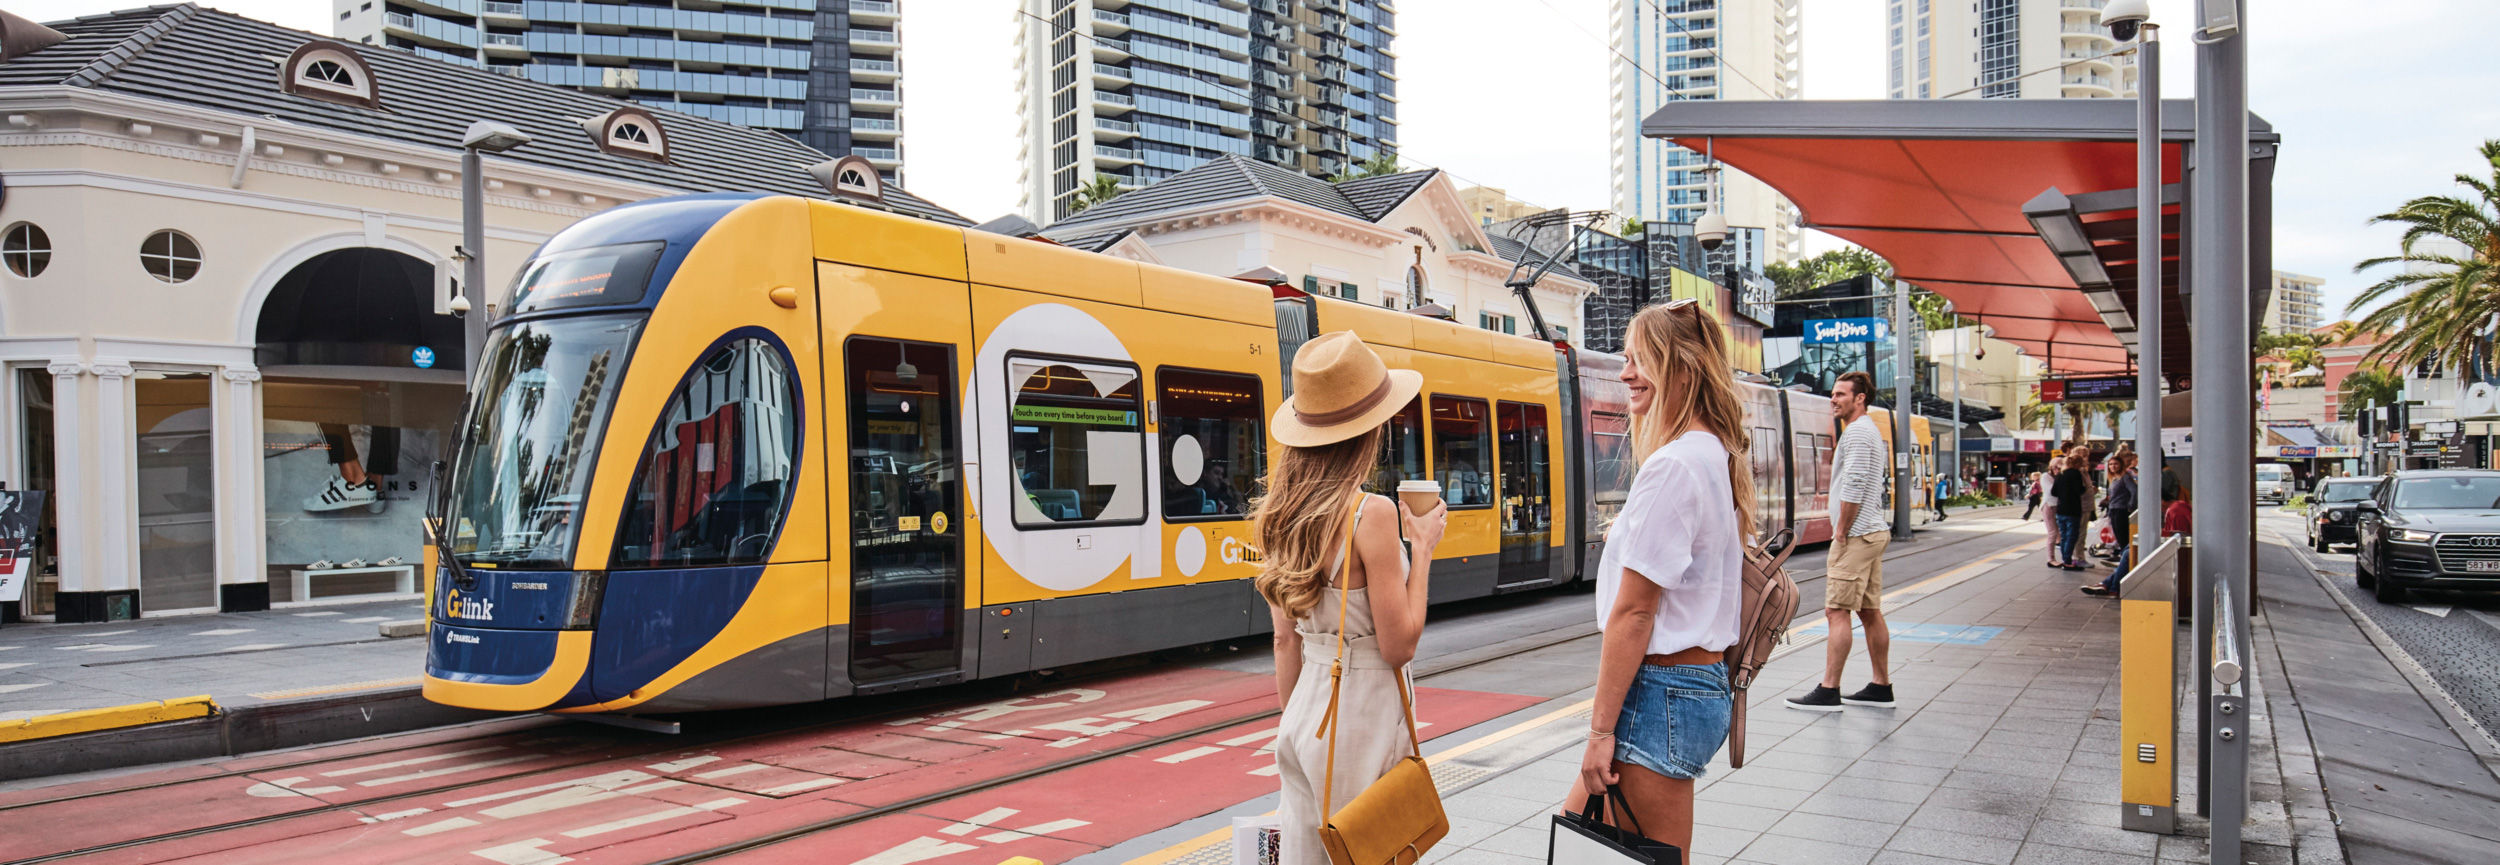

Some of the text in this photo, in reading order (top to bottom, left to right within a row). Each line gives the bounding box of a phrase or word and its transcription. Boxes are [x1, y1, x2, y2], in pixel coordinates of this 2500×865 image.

[1249, 343, 1262, 355] 5-1
[2056, 390, 2063, 399] 2
[1014, 408, 1033, 417] Touch
[1043, 411, 1061, 420] every
[1061, 410, 1075, 419] time
[1076, 411, 1095, 421] before
[1096, 414, 1107, 423] you
[1107, 413, 1124, 422] board
[447, 588, 494, 621] G:link
